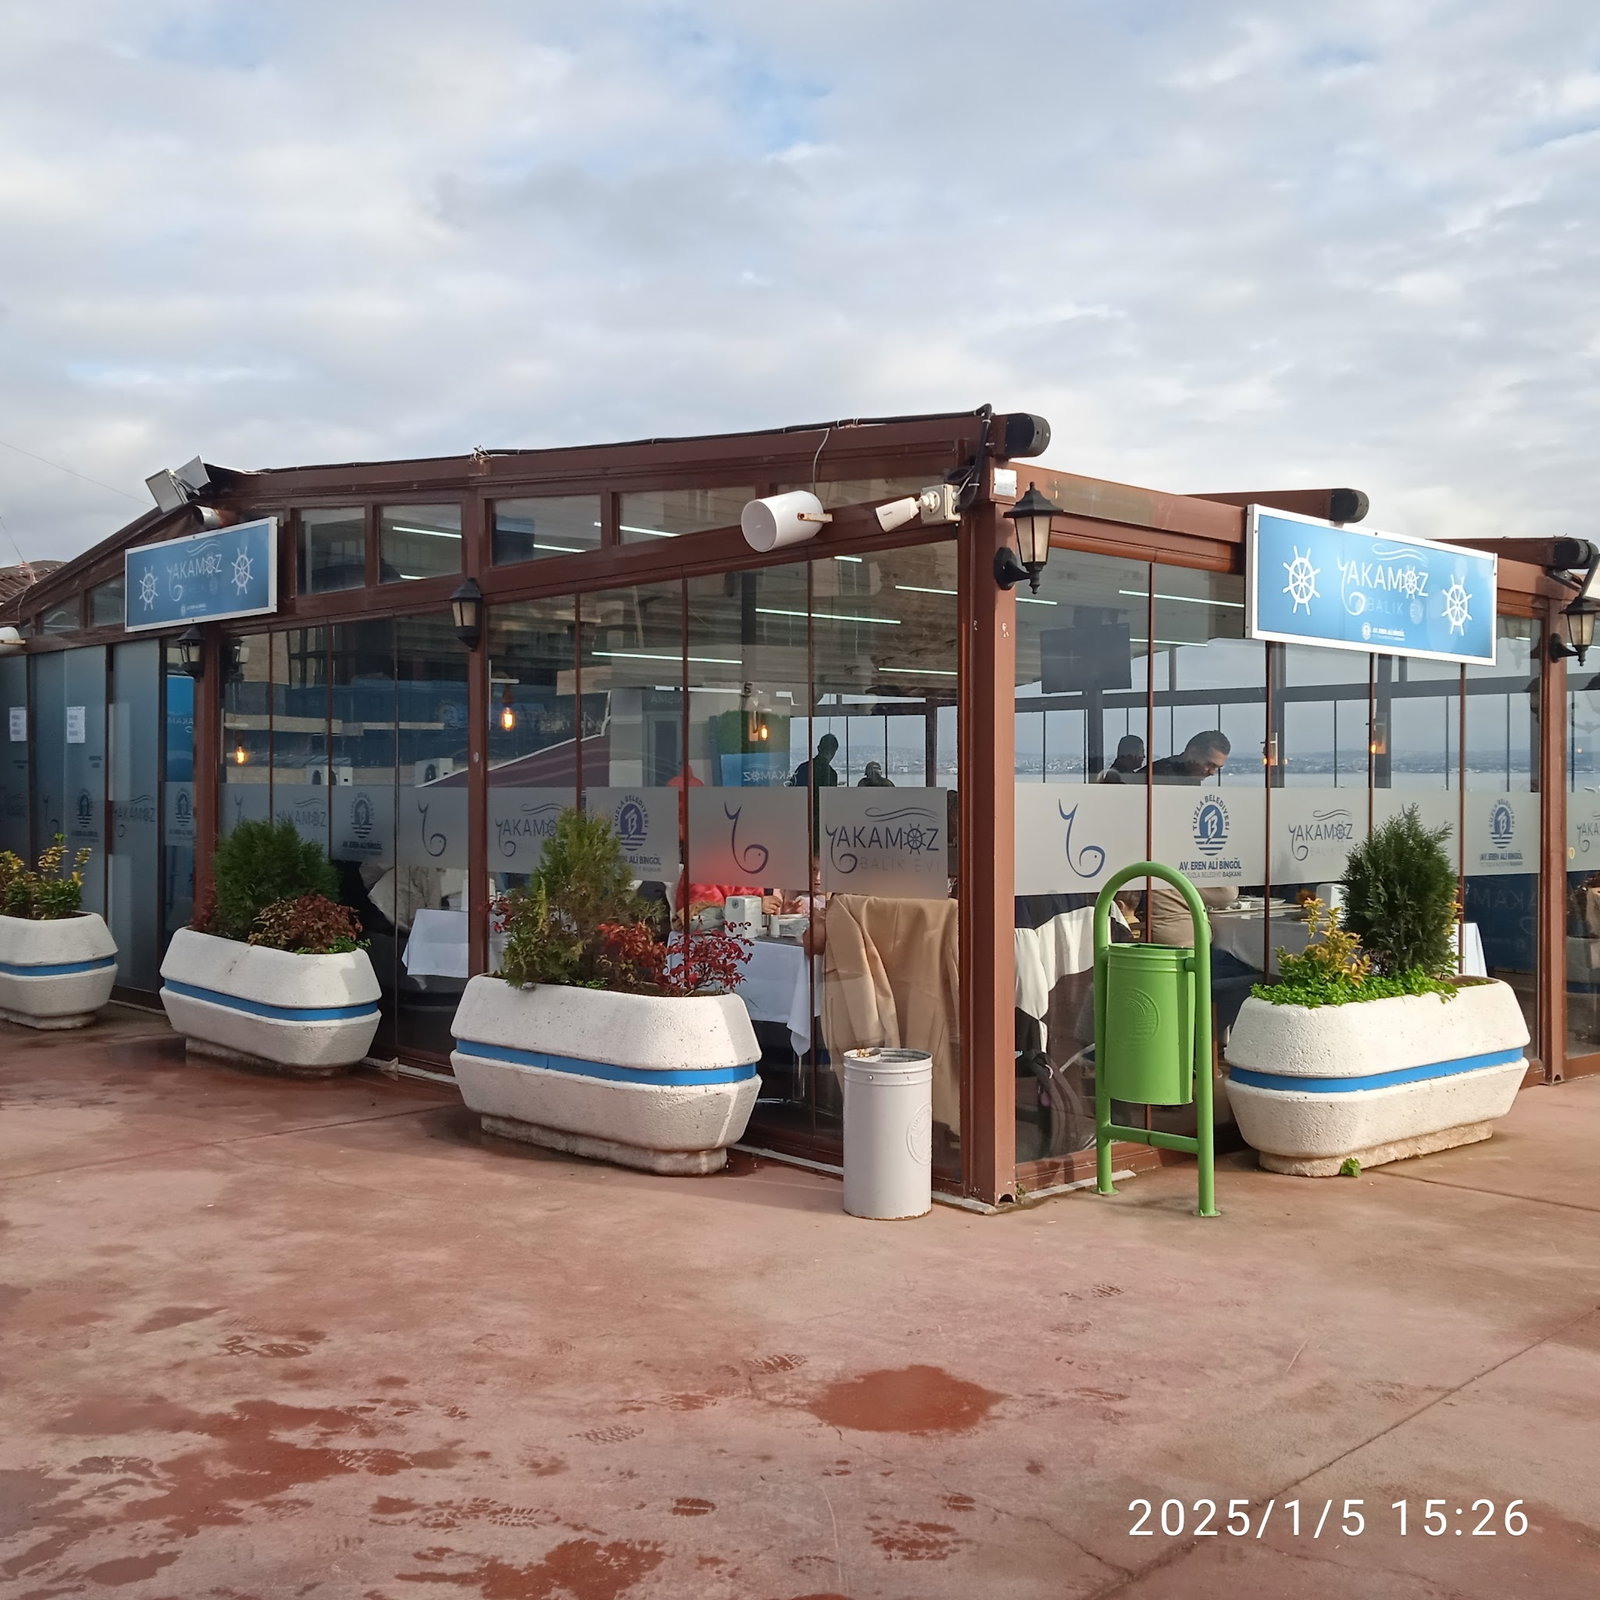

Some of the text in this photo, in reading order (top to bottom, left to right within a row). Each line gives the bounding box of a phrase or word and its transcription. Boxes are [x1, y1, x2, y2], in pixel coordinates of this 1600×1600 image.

[166, 553, 222, 602] YAKAMOZ
[1336, 554, 1429, 616] YAKAMOZ
[1192, 800, 1204, 831] TUZLA
[495, 816, 557, 857] YAKAMO
[824, 822, 940, 874] YAKAMOZ
[1288, 820, 1353, 861] YAKAMOZ
[859, 856, 905, 872] BALIK
[1190, 861, 1206, 870] EREN
